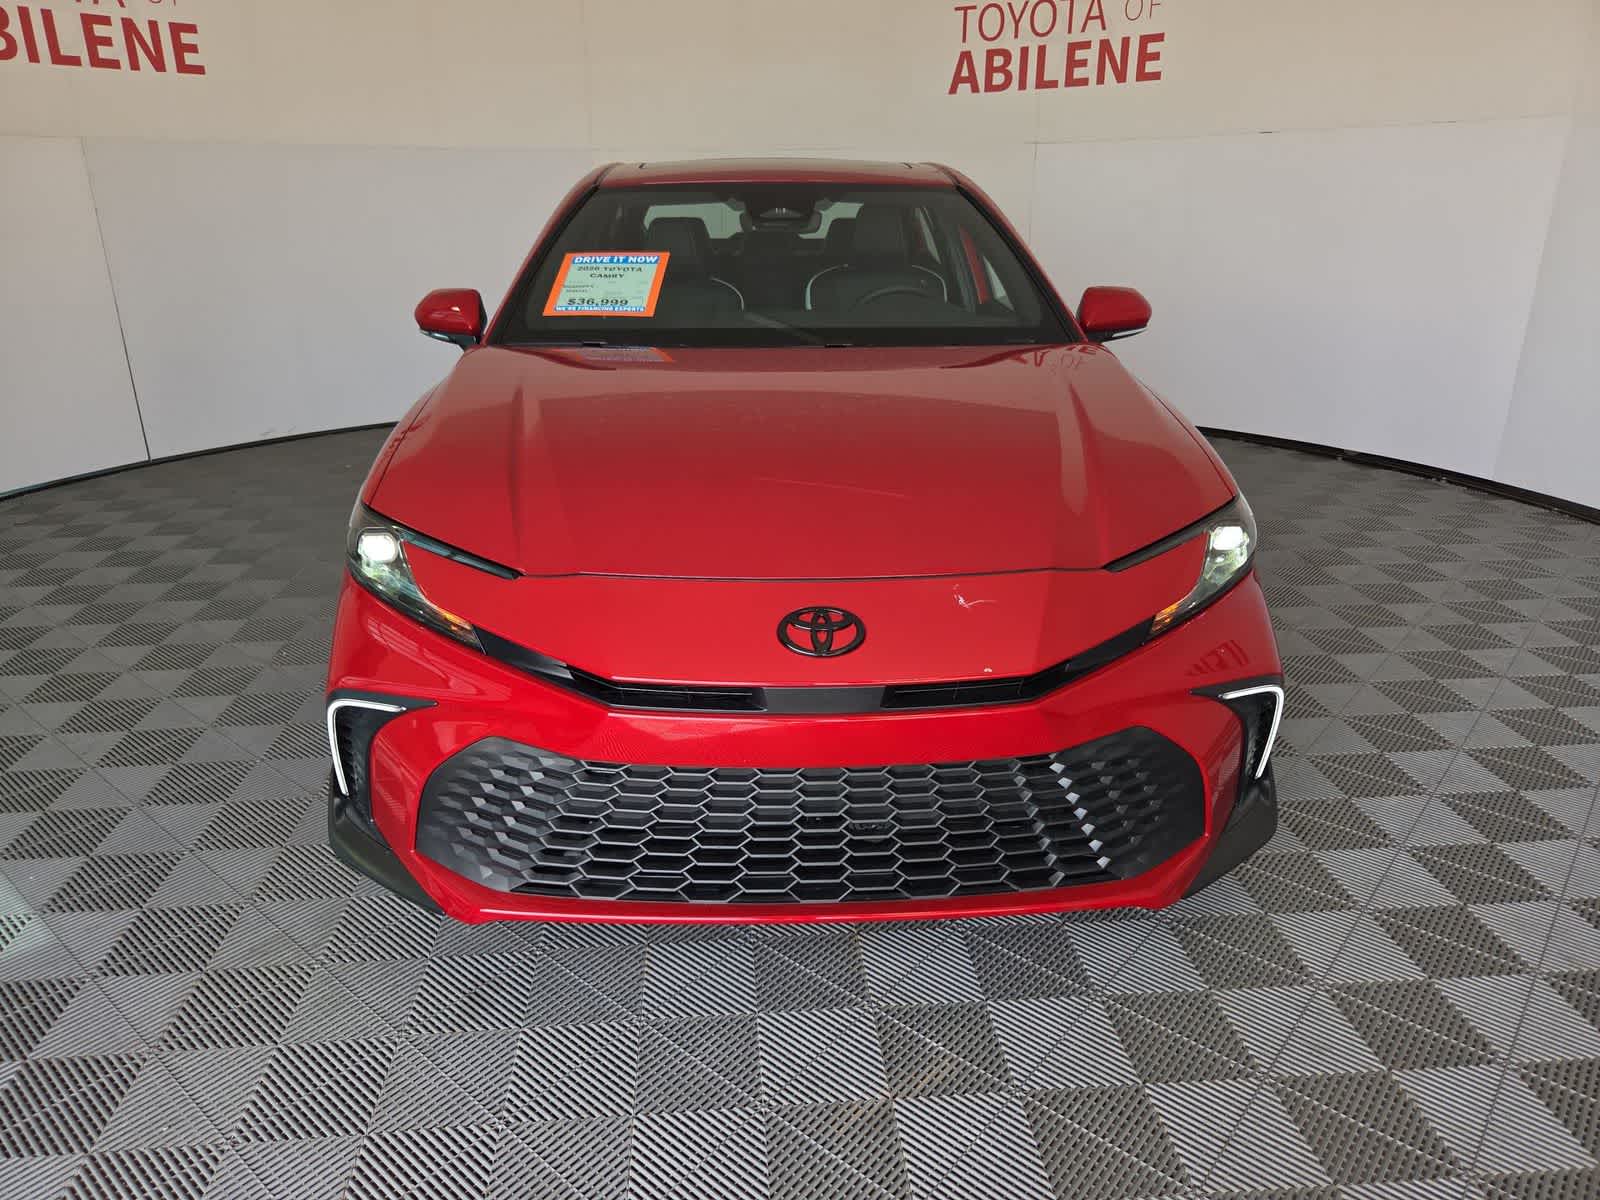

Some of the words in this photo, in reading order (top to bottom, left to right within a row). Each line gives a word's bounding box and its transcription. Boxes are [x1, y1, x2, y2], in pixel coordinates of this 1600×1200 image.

[954, 0, 1106, 43] TOYOTA
[1125, 0, 1162, 21] OF
[948, 32, 1165, 95] ABILENE
[567, 298, 629, 306] $36,999
